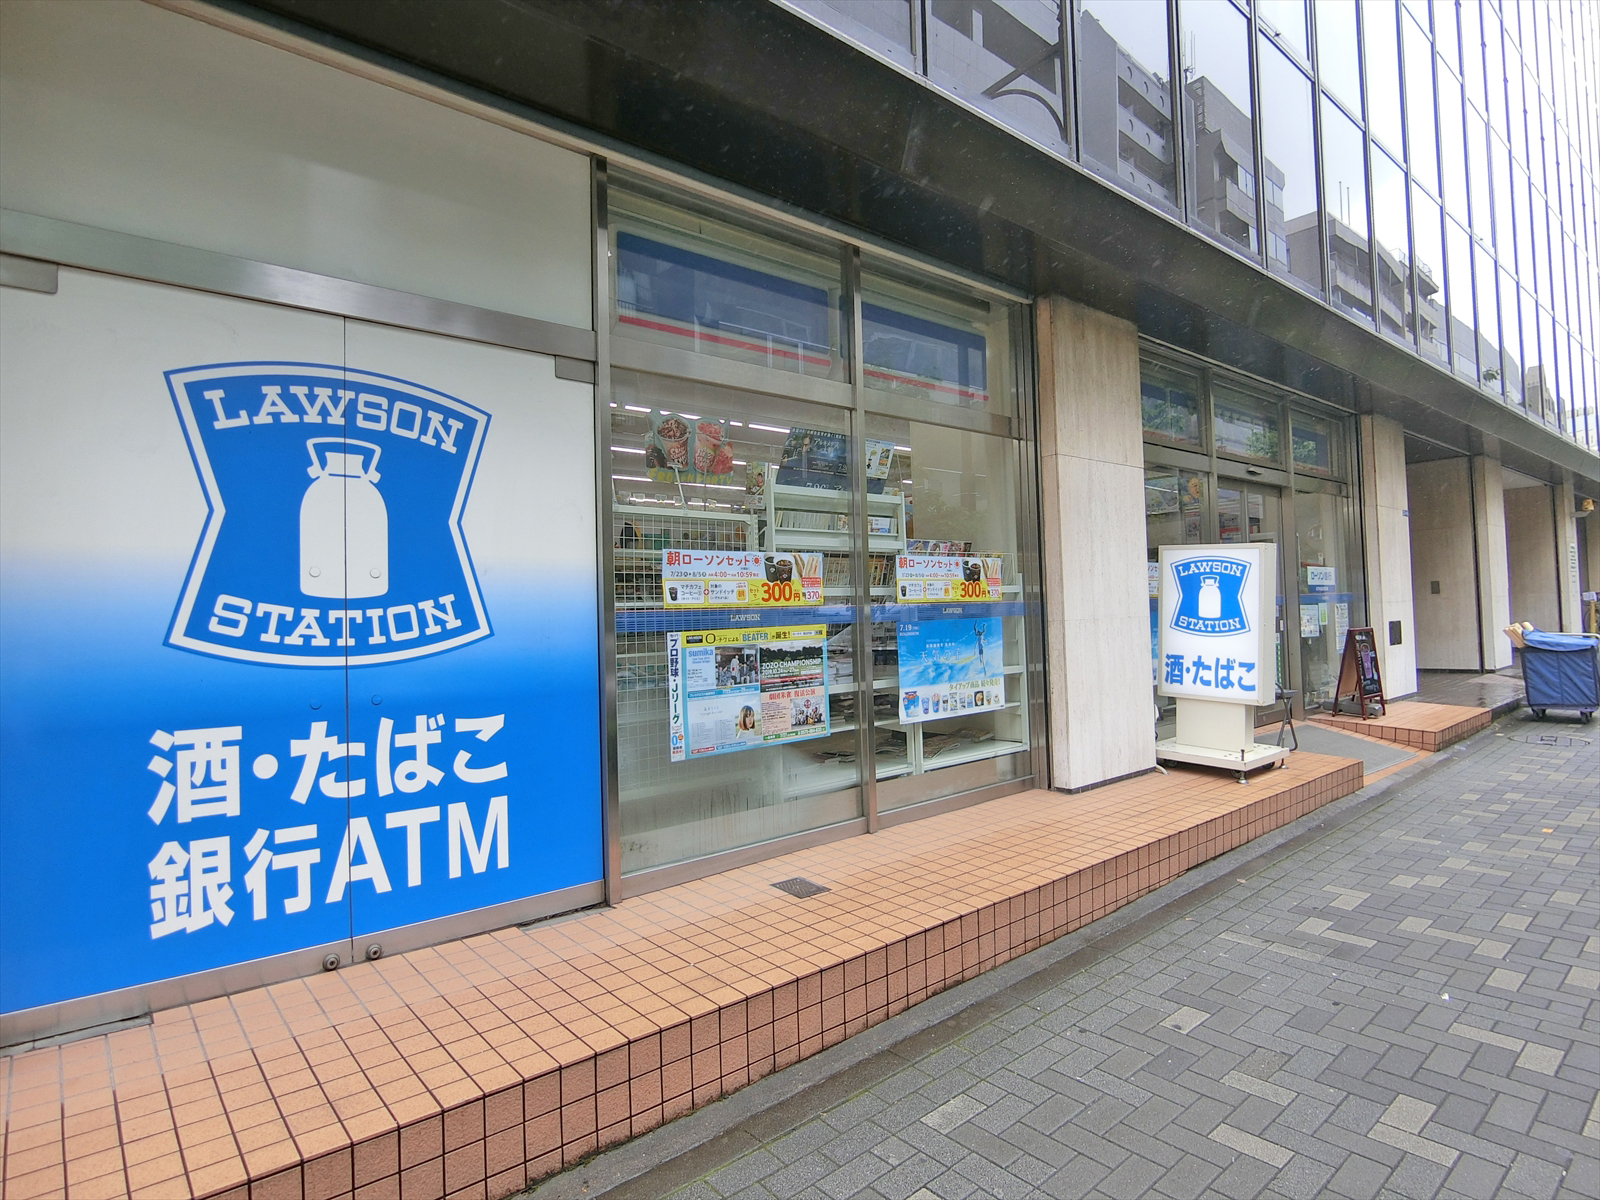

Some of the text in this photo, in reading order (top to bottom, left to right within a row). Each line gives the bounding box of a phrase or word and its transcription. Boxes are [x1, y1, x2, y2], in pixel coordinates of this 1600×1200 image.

[204, 385, 464, 454] LAWSON
[648, 467, 695, 483] FROEN
[666, 551, 750, 567] 朝ローソンセット
[898, 556, 953, 569] 朝ローソンセット
[1178, 561, 1243, 577] LAWSON
[208, 593, 463, 647] STATION
[730, 613, 760, 621] LAWSON
[1178, 615, 1241, 631] STATION
[742, 632, 769, 642] BEATER
[688, 648, 714, 657] sumika
[1164, 653, 1256, 692] 酒・たばこ
[147, 713, 509, 826] 酒・たばこ
[148, 795, 509, 941] 銀行ATM
